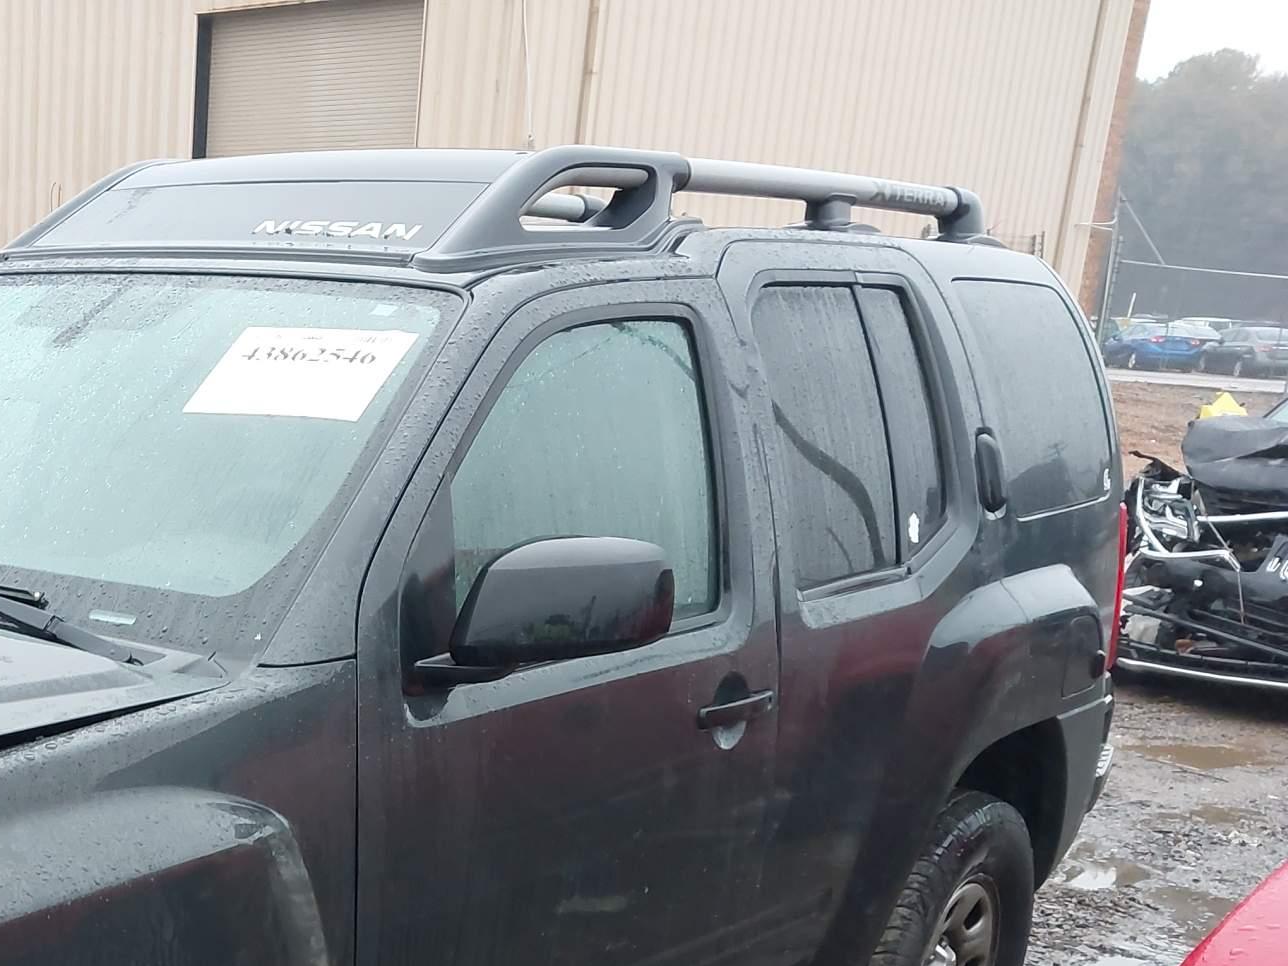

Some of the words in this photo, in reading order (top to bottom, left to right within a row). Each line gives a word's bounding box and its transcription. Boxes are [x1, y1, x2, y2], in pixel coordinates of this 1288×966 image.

[869, 181, 946, 206] XTERRA
[252, 220, 423, 240] NISSAN
[242, 346, 376, 364] 43862546
